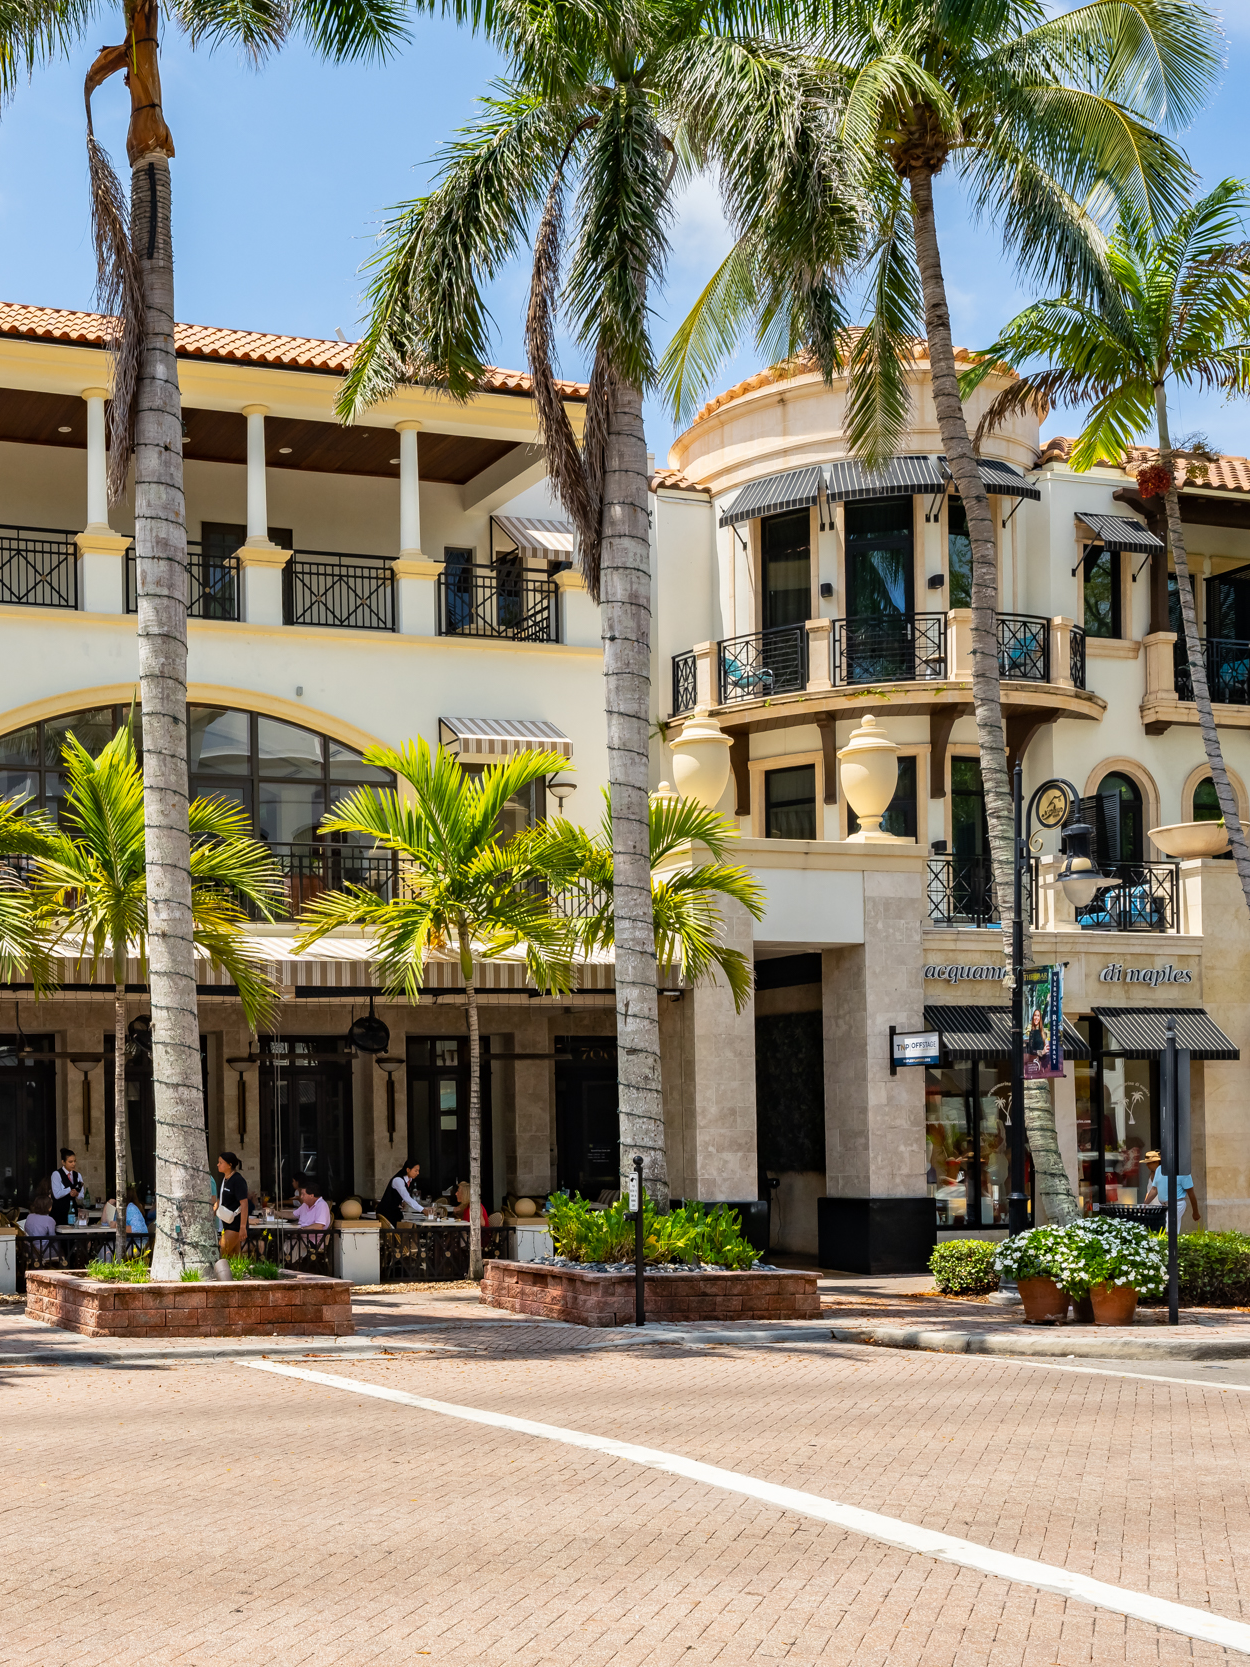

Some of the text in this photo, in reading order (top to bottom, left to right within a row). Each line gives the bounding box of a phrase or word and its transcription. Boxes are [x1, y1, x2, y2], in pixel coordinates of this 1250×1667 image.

[924, 965, 1008, 984] acquam
[1100, 964, 1193, 987] di naples
[896, 1043, 910, 1052] TNP
[911, 1040, 937, 1050] OFFSTAGE
